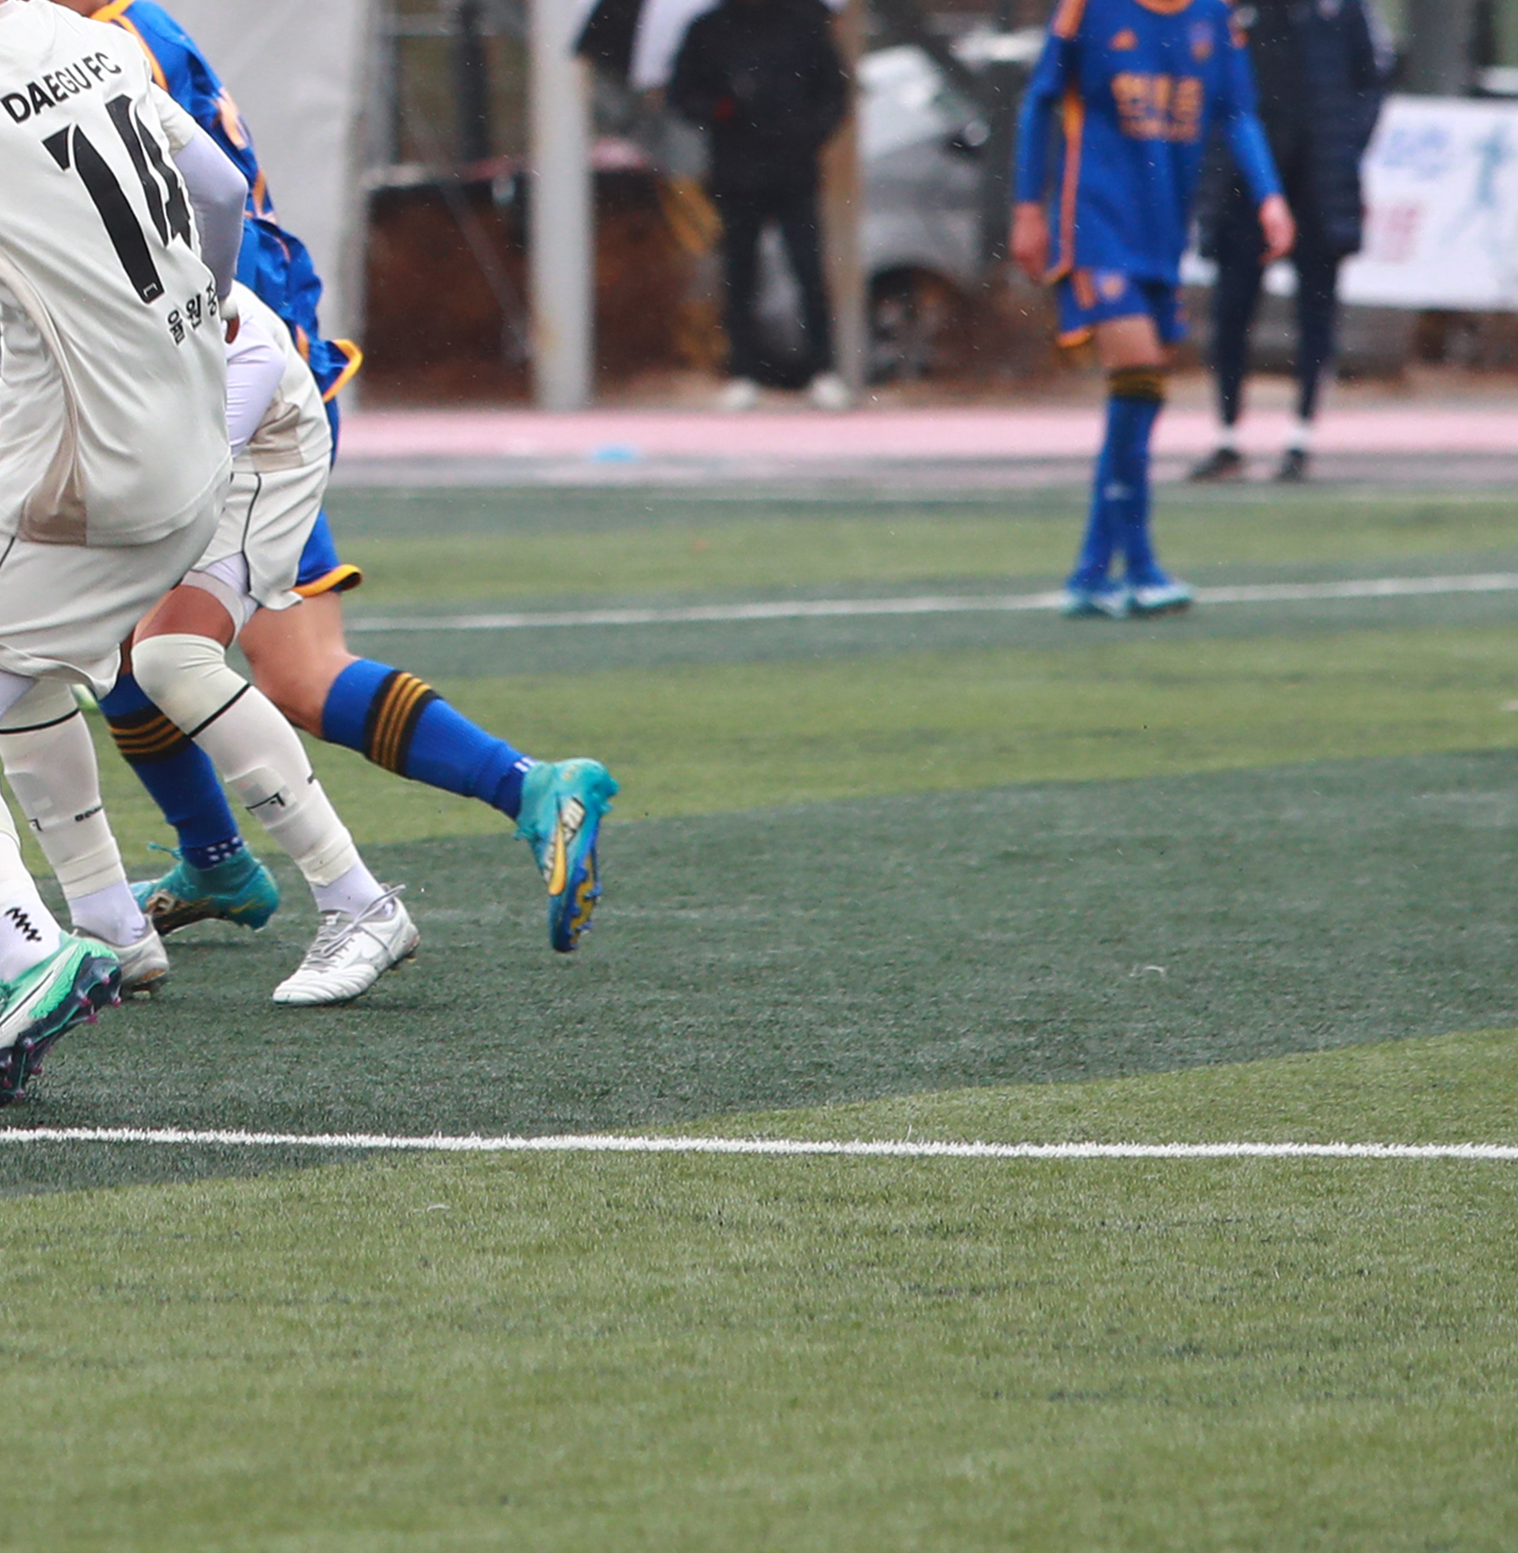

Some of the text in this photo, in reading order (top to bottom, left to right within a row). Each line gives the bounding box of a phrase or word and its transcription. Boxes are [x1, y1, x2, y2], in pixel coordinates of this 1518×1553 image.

[0, 51, 122, 124] DAEGU FC
[41, 93, 194, 305] 14
